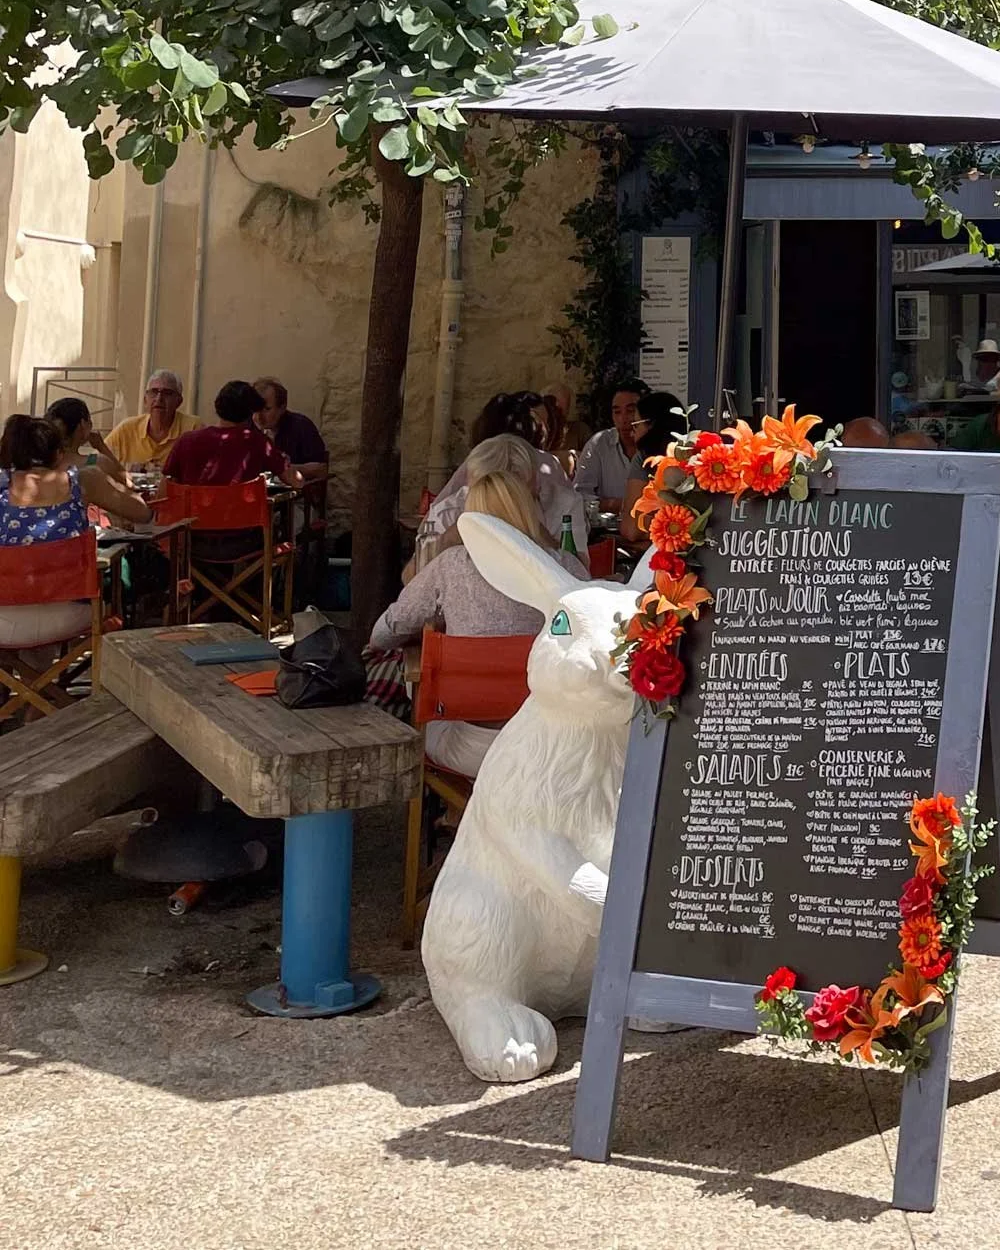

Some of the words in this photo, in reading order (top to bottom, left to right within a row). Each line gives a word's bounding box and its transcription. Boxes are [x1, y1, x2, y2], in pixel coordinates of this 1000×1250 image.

[766, 498, 820, 525] LAPIN
[718, 526, 852, 558] SUGGESTIONS
[779, 573, 803, 585] FRAIS
[812, 572, 855, 585] COURGETTES
[903, 570, 933, 588] 13€
[781, 559, 810, 572] FLEURS
[813, 560, 823, 571] DE
[825, 558, 872, 572] COURGETTES
[875, 558, 906, 571] FARCIES
[907, 562, 918, 571] AU
[714, 587, 768, 614] PLATS
[769, 595, 783, 610] DU
[782, 583, 832, 614] JOUR
[708, 649, 788, 681] ENTRÉES
[844, 651, 910, 679] PLATS
[690, 753, 781, 786] SALADES
[819, 749, 895, 765] CONSERVERIE
[868, 764, 891, 778] FINE
[680, 855, 764, 888] DESSERTS
